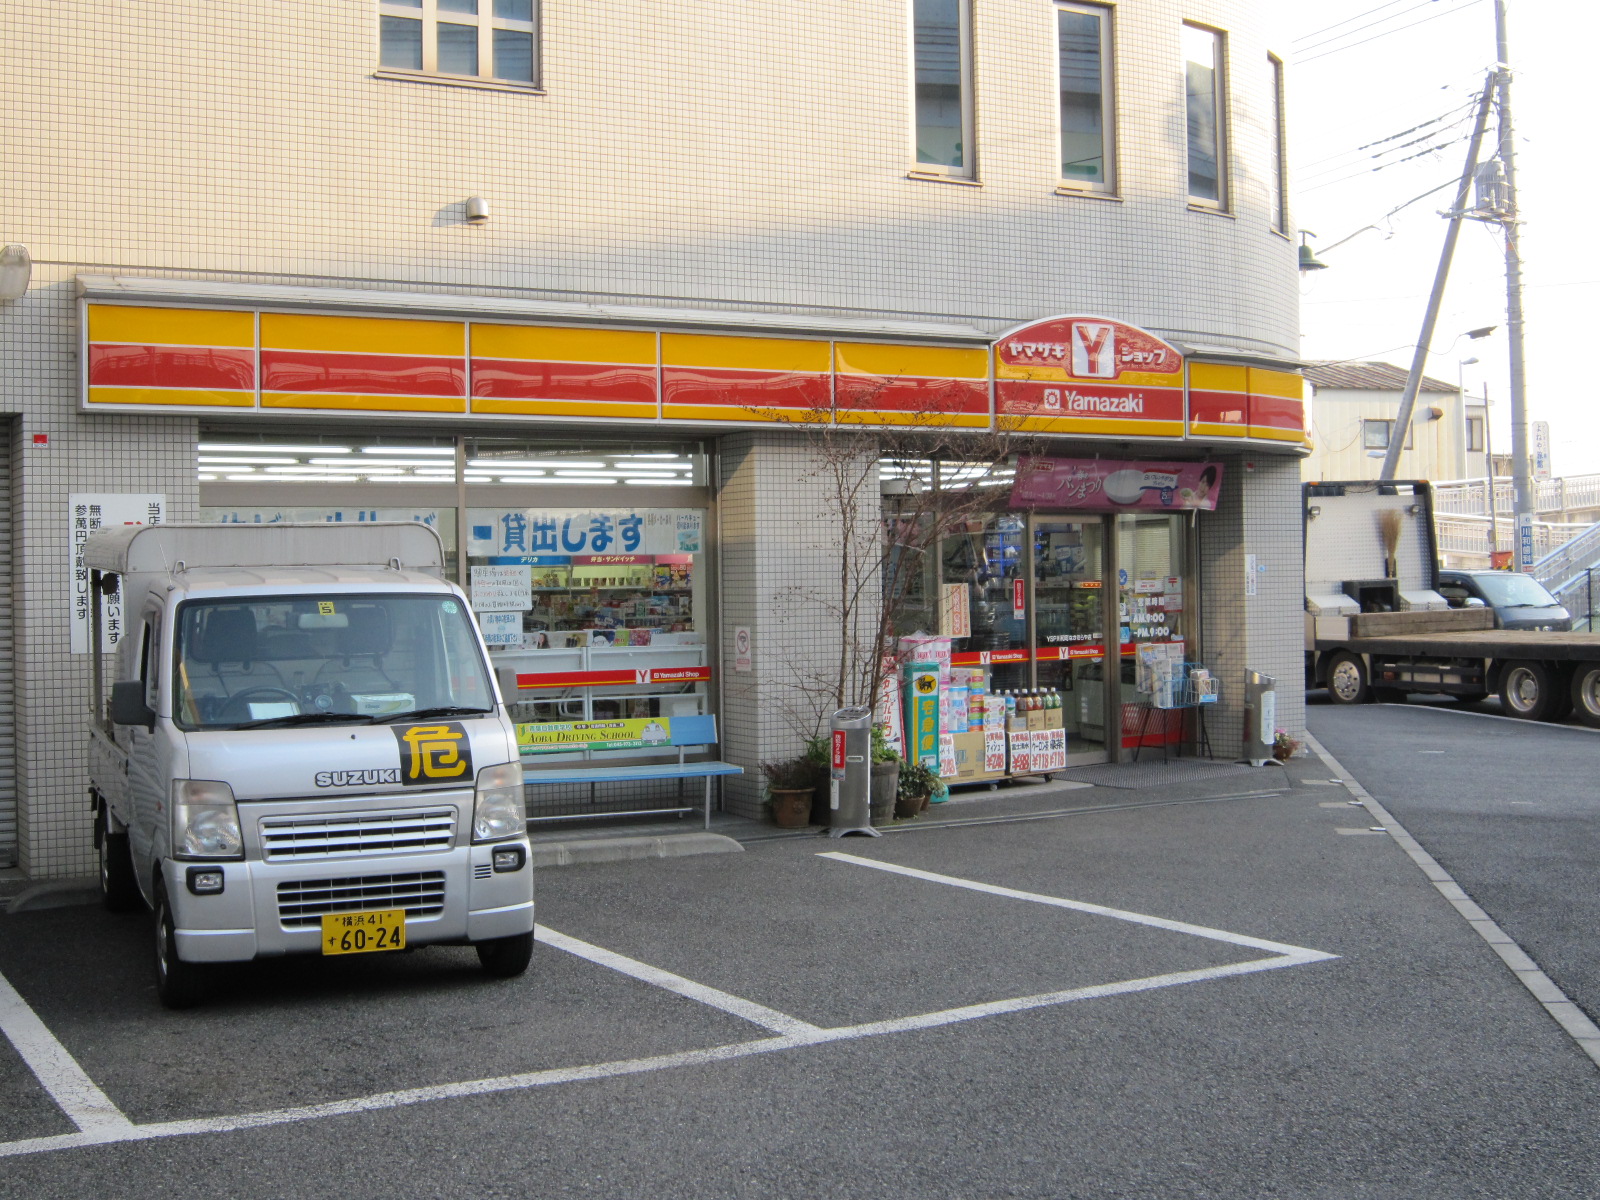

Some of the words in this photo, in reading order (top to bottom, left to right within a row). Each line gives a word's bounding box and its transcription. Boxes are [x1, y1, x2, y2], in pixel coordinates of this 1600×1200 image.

[1008, 342, 1065, 359] ヤマザキ
[1076, 325, 1111, 374] Y
[1120, 345, 1167, 364] ショップ
[1064, 390, 1143, 413] Yamazaki
[89, 504, 101, 534] 無断
[501, 512, 643, 552] 貸出します
[590, 555, 635, 563] 弁当・サンドイッチ
[638, 670, 648, 682] Y
[921, 700, 935, 751] 宅急便
[402, 725, 467, 779] 危
[1031, 753, 1049, 769] ¥118
[315, 768, 401, 788] SUZUKI
[342, 915, 365, 927] 横浜
[368, 914, 383, 925] 41
[341, 926, 400, 951] 60-24
